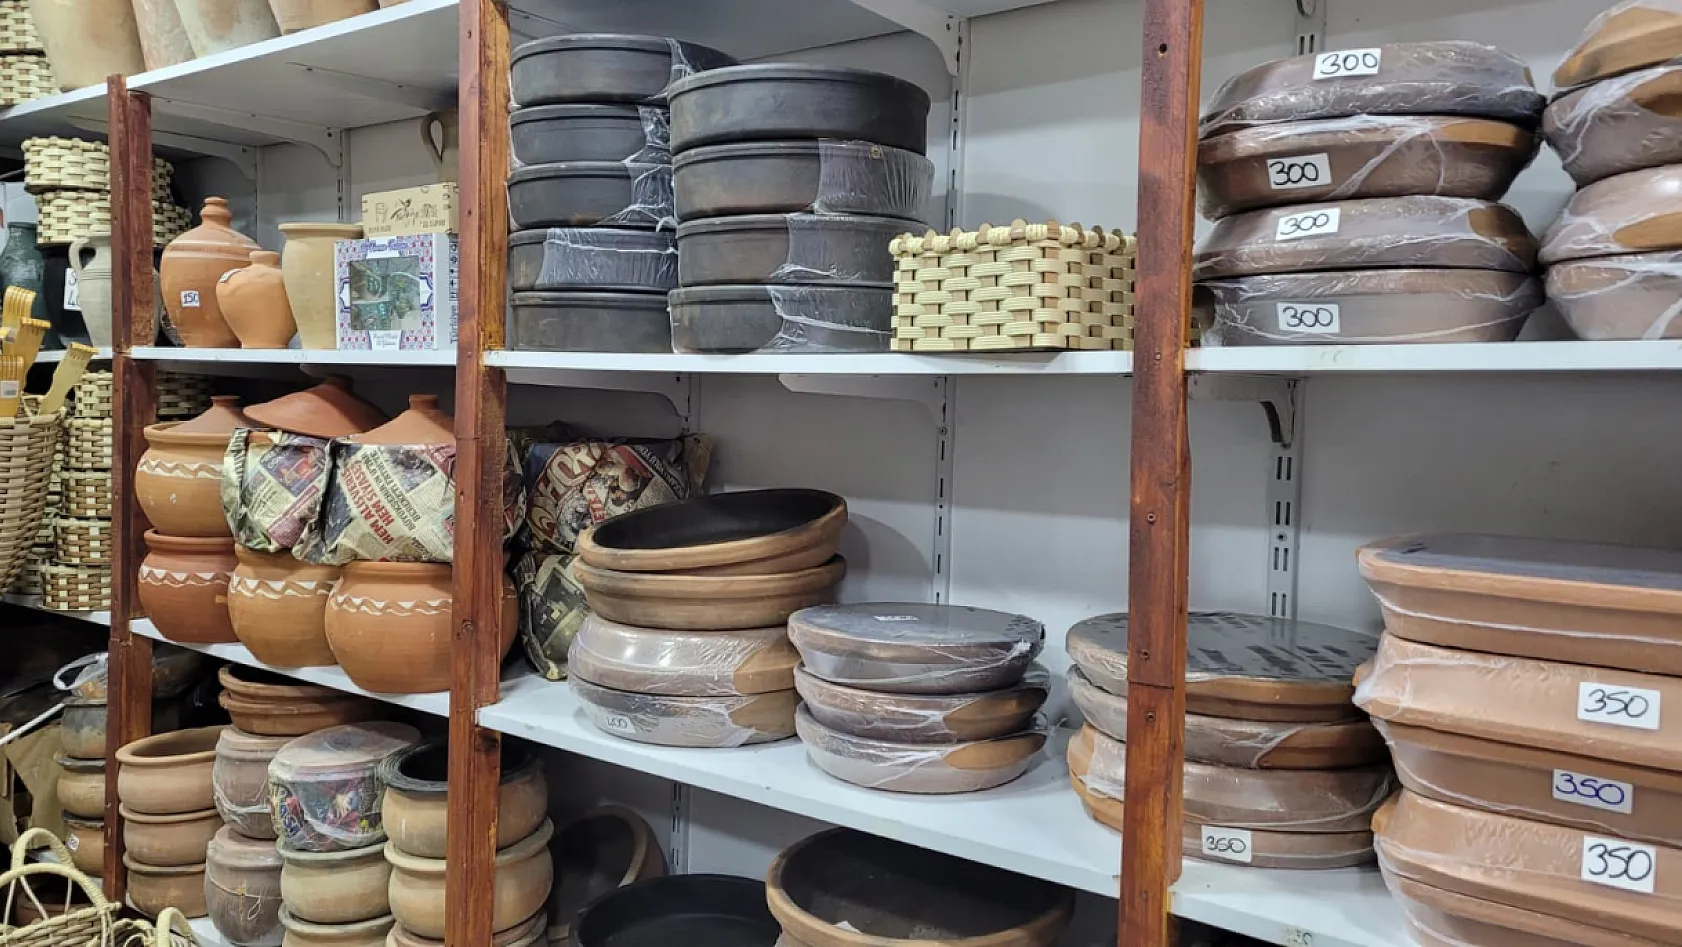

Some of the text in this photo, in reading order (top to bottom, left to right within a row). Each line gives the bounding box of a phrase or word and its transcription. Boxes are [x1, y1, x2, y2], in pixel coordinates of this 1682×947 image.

[1320, 53, 1377, 74] 300
[1269, 161, 1319, 185] 300
[1280, 213, 1329, 235] 300
[1283, 306, 1333, 327] 300
[371, 500, 393, 526] HEM
[368, 518, 393, 544] HEM
[1584, 688, 1649, 718] 350
[1555, 773, 1624, 805] 350
[1206, 836, 1246, 853] 350
[1588, 843, 1652, 881] 350
